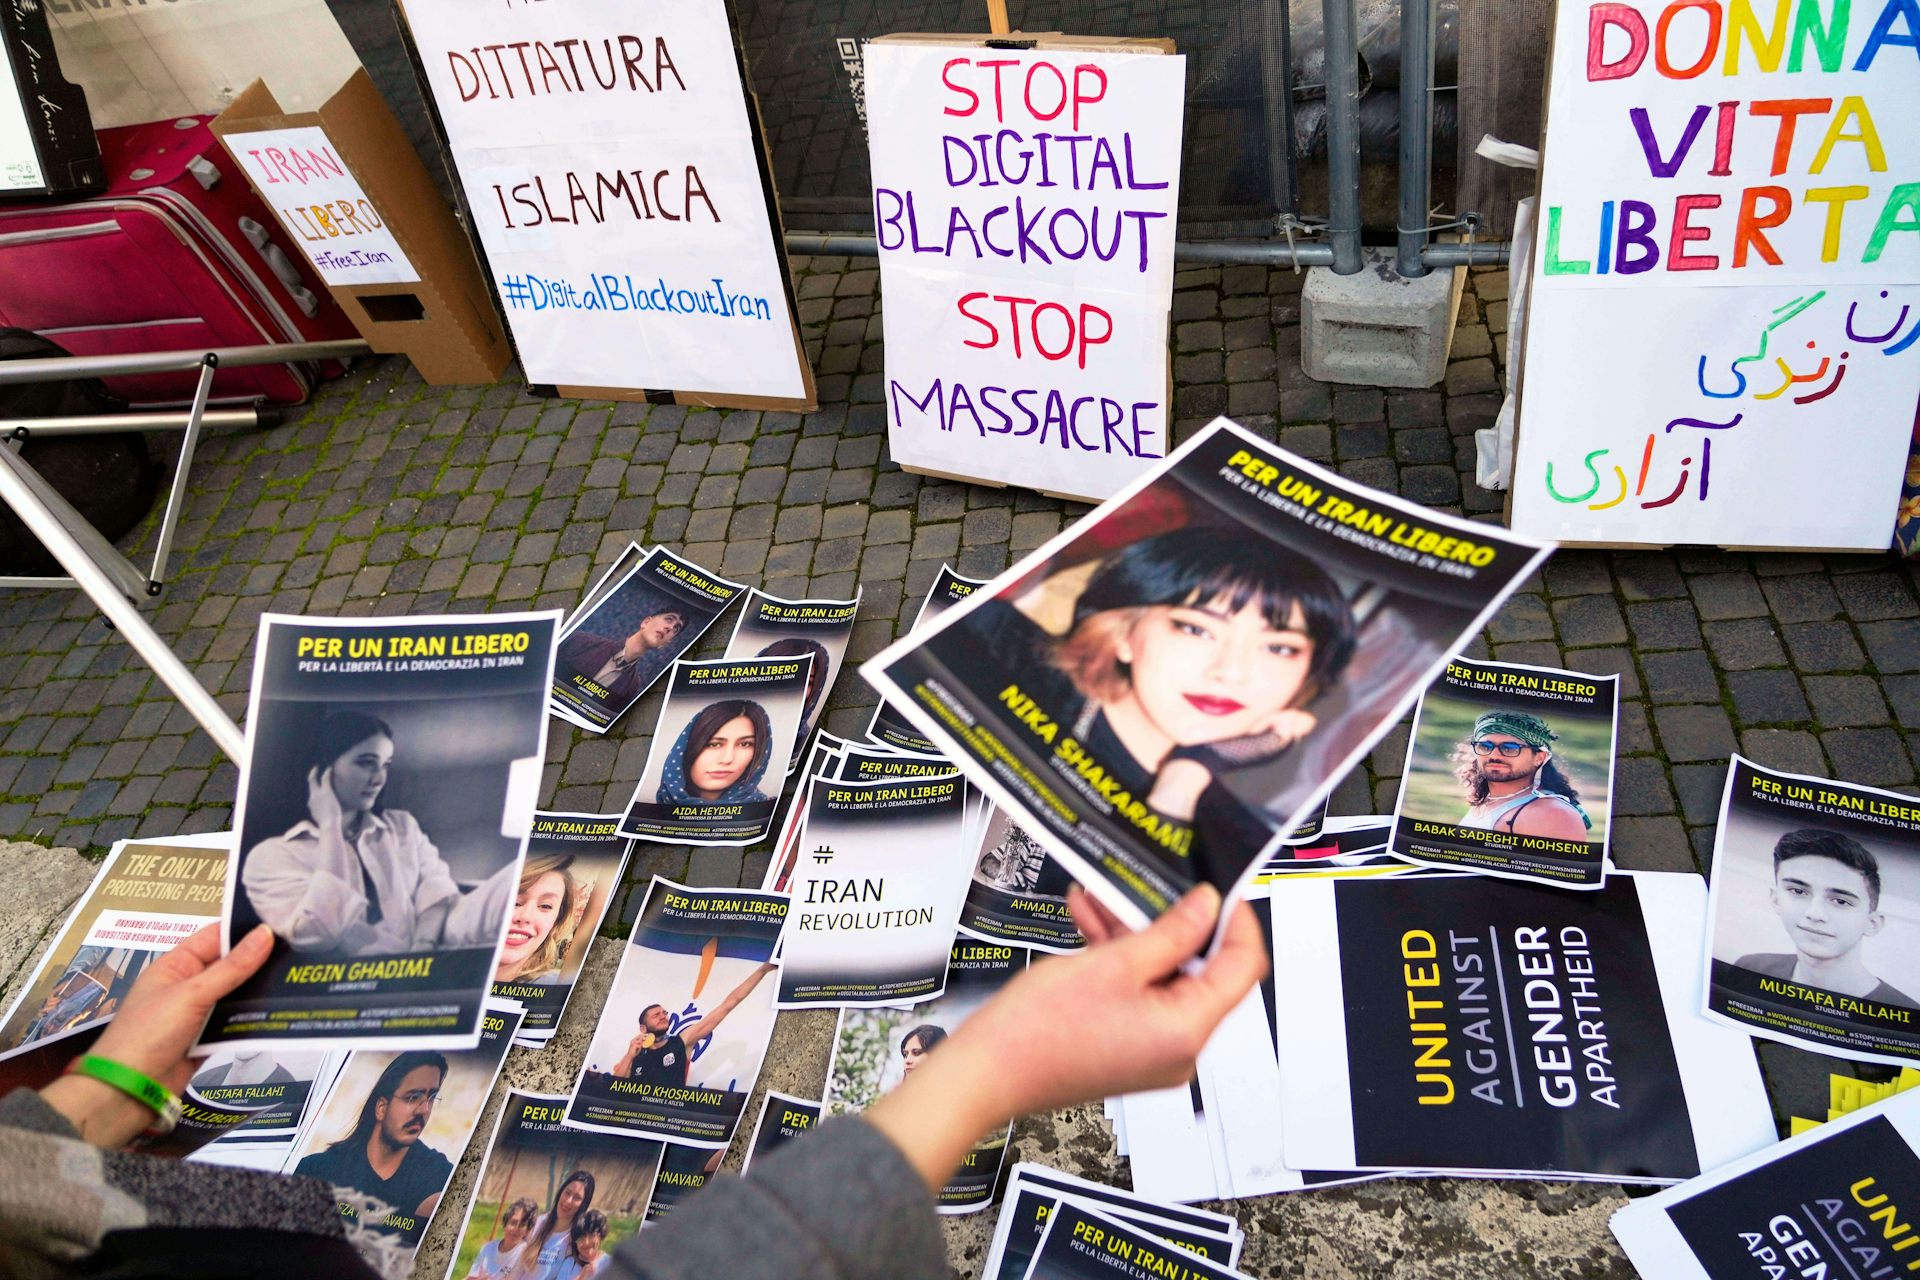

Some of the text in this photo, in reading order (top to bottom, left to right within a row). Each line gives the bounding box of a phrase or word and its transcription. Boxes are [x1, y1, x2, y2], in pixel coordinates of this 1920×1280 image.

[1587, 0, 1920, 82] DONNA
[448, 35, 686, 102] DITTATURA
[942, 58, 1108, 131] STOP
[1629, 96, 1888, 178] VITA
[249, 146, 344, 186] IRAN
[943, 130, 1168, 191] DIGITAL
[493, 165, 721, 229] ISLAMICA
[284, 198, 381, 241] LIBERO
[876, 188, 1167, 273] BLACKOUT
[315, 249, 392, 271] #FreeIran
[503, 273, 771, 320] #DigitalBlackoutIran
[957, 292, 1113, 370] STOP
[891, 377, 1163, 459] MASSACRE
[1227, 450, 1496, 568] PER UN IRAN LIBERO
[659, 559, 733, 599] PER UN IRAN LIBERO
[761, 603, 826, 617] PER UN IRAN
[298, 632, 530, 658] PER UN IRAN LIBERO
[298, 656, 524, 672] PER LA LIBERTÀ E LA DEMOCRAZIA IN IRAN
[689, 664, 799, 679] PER UN IRAN LIBERO
[1447, 663, 1597, 697] PER UN IRAN LIBERO
[573, 675, 587, 685] ALI
[584, 681, 609, 699] ABBASI
[1446, 676, 1594, 704] PER LA LIBERTÀ E LA DEMOCRAZIA IN IRAN
[998, 684, 1060, 745] NIKA
[828, 783, 954, 802] PER UN IRAN LIBERO
[888, 798, 927, 808] DEMOCRAZIA
[937, 795, 951, 803] IRAN
[1751, 776, 1783, 796] PER
[1787, 785, 1813, 802] UN
[1818, 791, 1864, 811] IRAN
[672, 806, 742, 816] AIDA HEYDARI
[1752, 791, 1767, 801] PER
[1768, 795, 1779, 803] LA
[1781, 797, 1814, 811] LIBERTÀ
[1824, 806, 1835, 814] LA
[1837, 809, 1894, 826] DEMOCRAZIA
[1897, 821, 1908, 829] IN
[538, 822, 584, 833] UN IRAN
[1414, 822, 1589, 855] BABAK SADEGHI MOHSENI
[812, 845, 834, 865] #
[1484, 842, 1513, 850] STUDENTE
[122, 854, 208, 880] THE ONLY
[102, 879, 225, 903] PROTESTING PEOP
[665, 894, 788, 917] PER UN IRAN LIBERO
[804, 878, 884, 904] IRAN
[1010, 899, 1054, 915] AHMAD
[799, 907, 934, 931] REVOLUTION
[962, 947, 1012, 960] LIBERO
[285, 957, 434, 984] NEGIN GHADIMI
[500, 985, 546, 998] AMINIAN
[1759, 978, 1911, 1024] MUSTAFA FALLAHI
[1401, 929, 1455, 1105] UNITED
[1448, 930, 1503, 1106] AGAINST
[1514, 925, 1578, 1108] GENDER
[1560, 925, 1620, 1109] APARTHEID
[1815, 1004, 1850, 1018] STUDENTE
[200, 1086, 285, 1099] MUSTAFA FALLAHI
[610, 1080, 723, 1106] AHMAD KHOSRAVANI
[1070, 1239, 1127, 1273] PER LA LIBERTÀ
[1073, 1220, 1179, 1280] PER UN IRAN
[1815, 1199, 1908, 1280] AGAI
